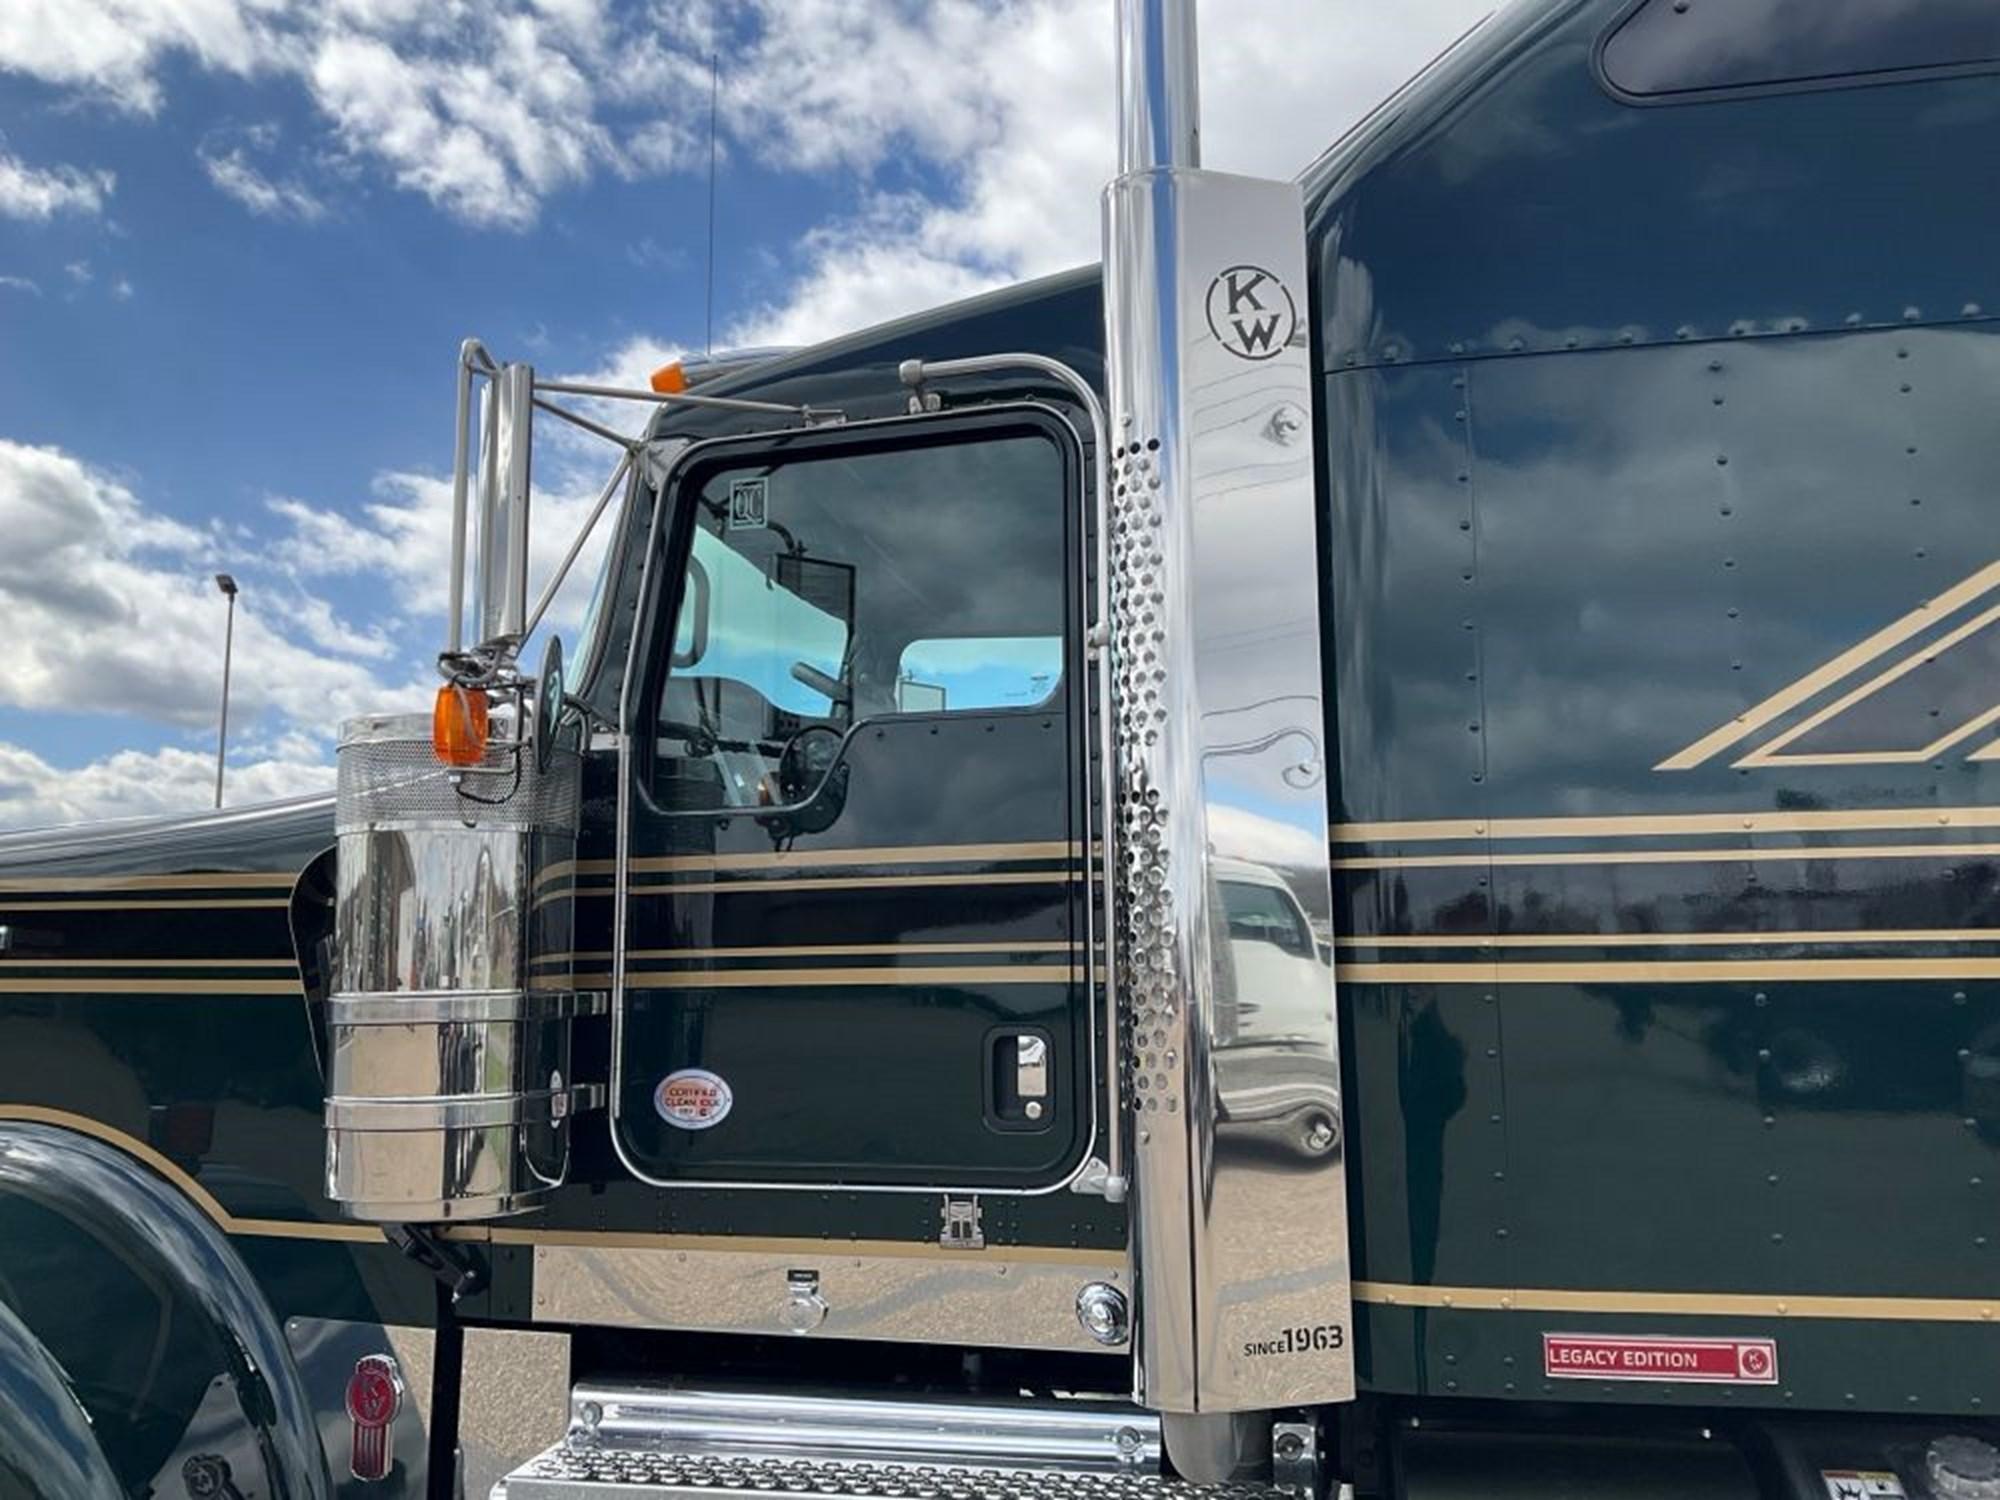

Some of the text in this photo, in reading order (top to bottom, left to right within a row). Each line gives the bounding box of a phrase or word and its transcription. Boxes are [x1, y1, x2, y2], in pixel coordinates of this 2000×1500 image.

[1243, 1325, 1344, 1357] SINCE 1963
[1549, 1348, 1698, 1368] LEGACY EDITION
